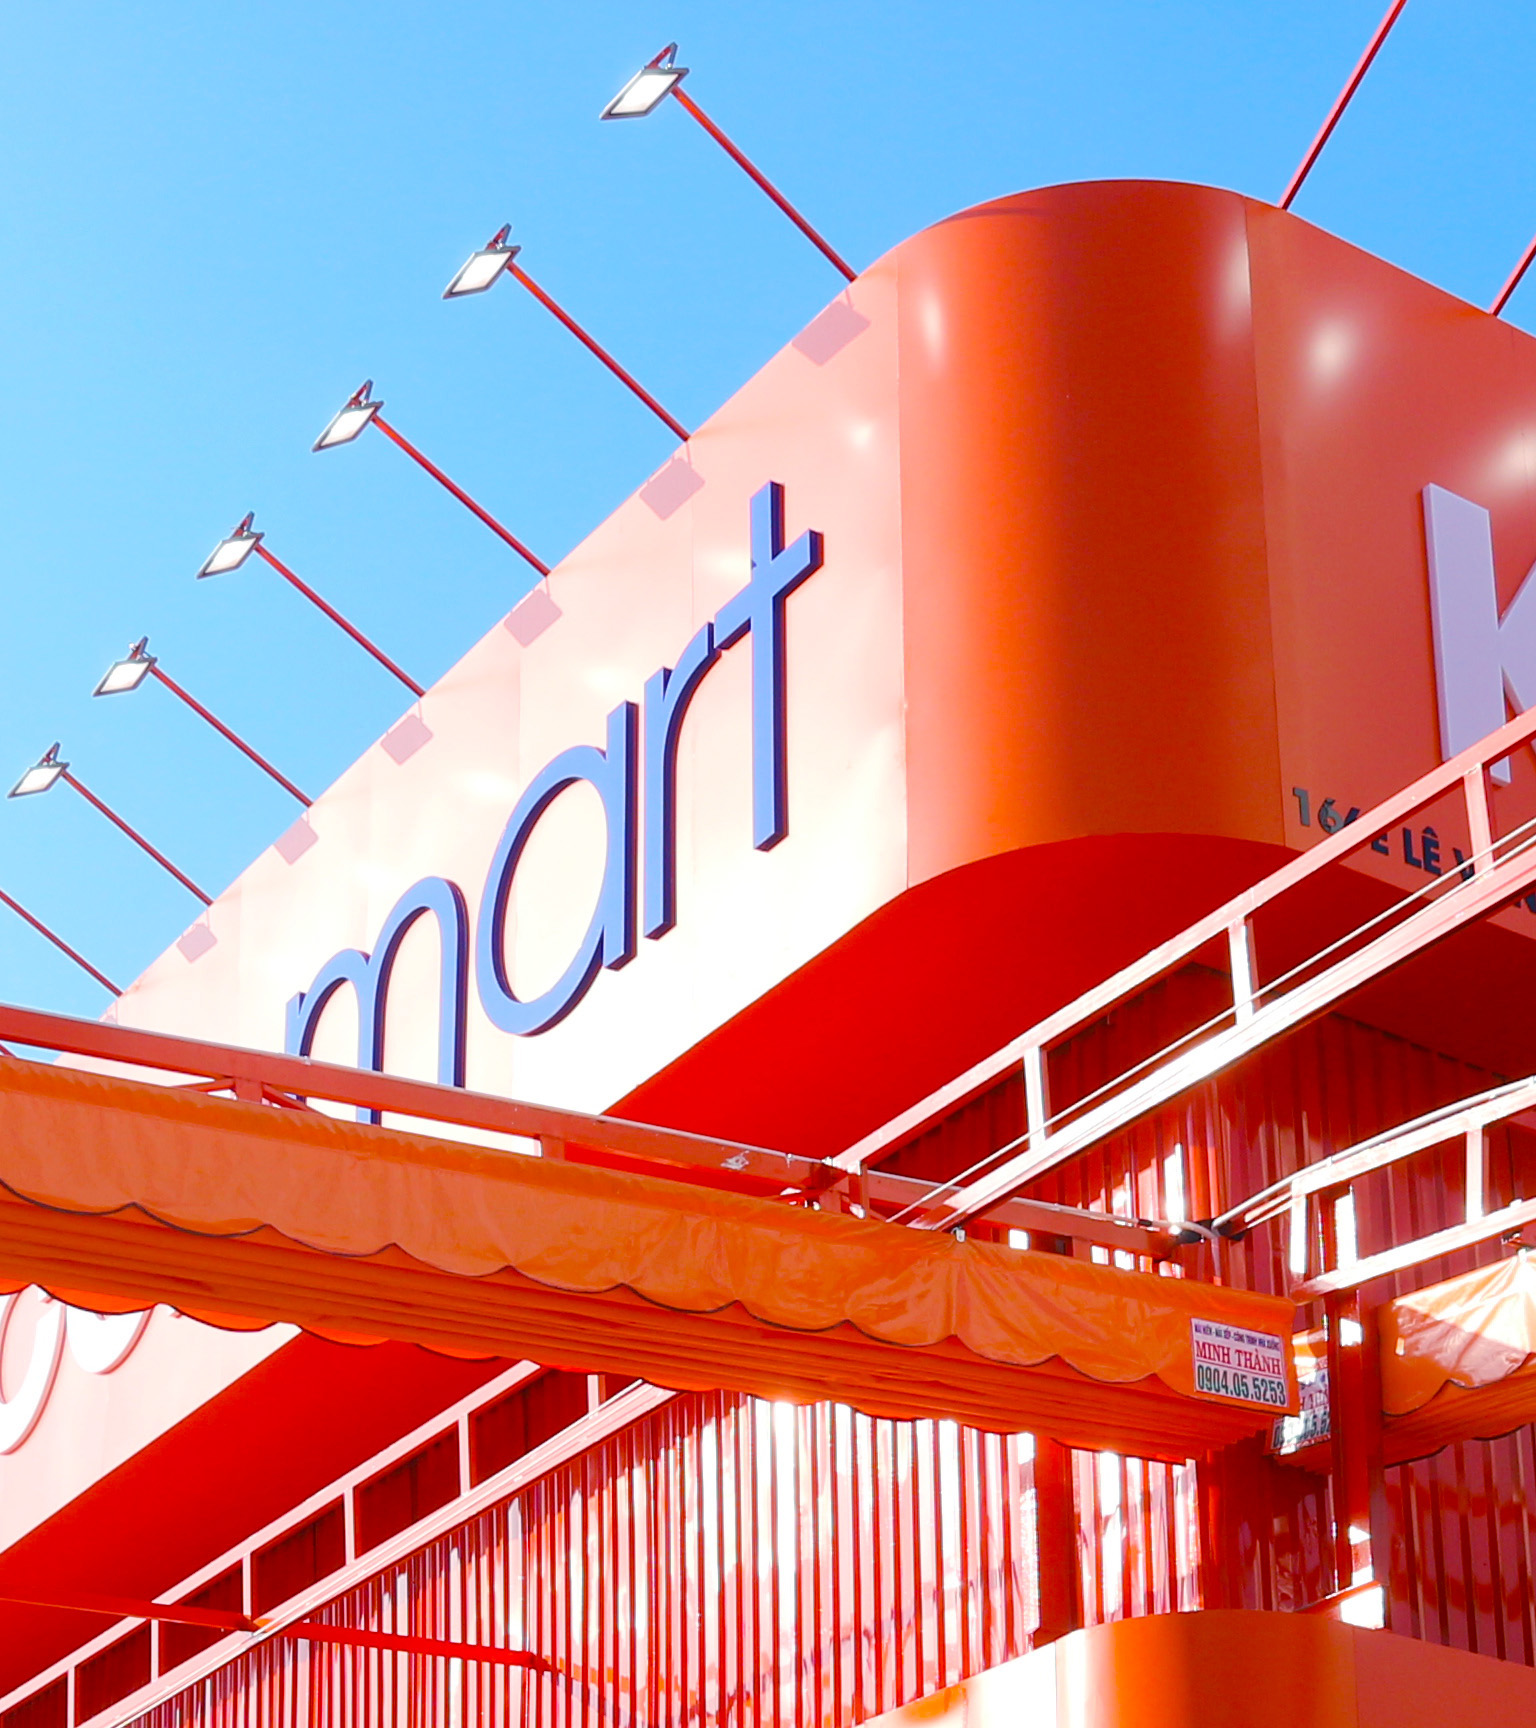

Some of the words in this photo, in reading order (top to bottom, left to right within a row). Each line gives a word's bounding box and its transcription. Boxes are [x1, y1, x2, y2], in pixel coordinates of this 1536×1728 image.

[1402, 826, 1442, 876] LÊ
[1195, 1340, 1231, 1364] MINH
[1235, 1348, 1282, 1375] THÀNH
[1197, 1364, 1286, 1405] 0904.05.5253
